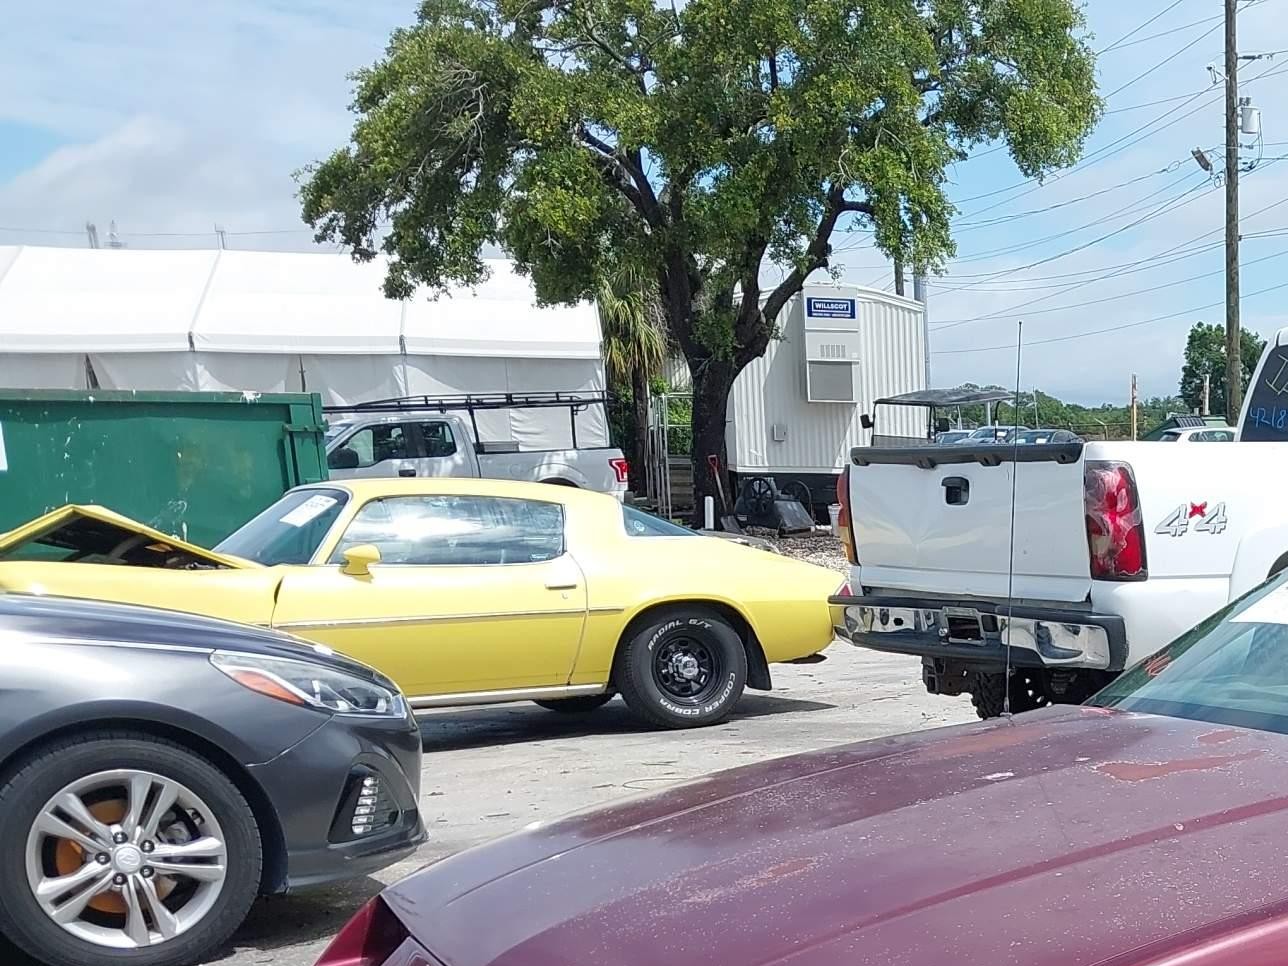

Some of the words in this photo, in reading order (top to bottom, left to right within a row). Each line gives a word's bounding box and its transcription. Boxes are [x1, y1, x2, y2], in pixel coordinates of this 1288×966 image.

[815, 302, 848, 310] WILLSCOT
[648, 620, 684, 650] RADIAL
[704, 672, 736, 713] COOPER
[659, 698, 700, 715] COBRA
